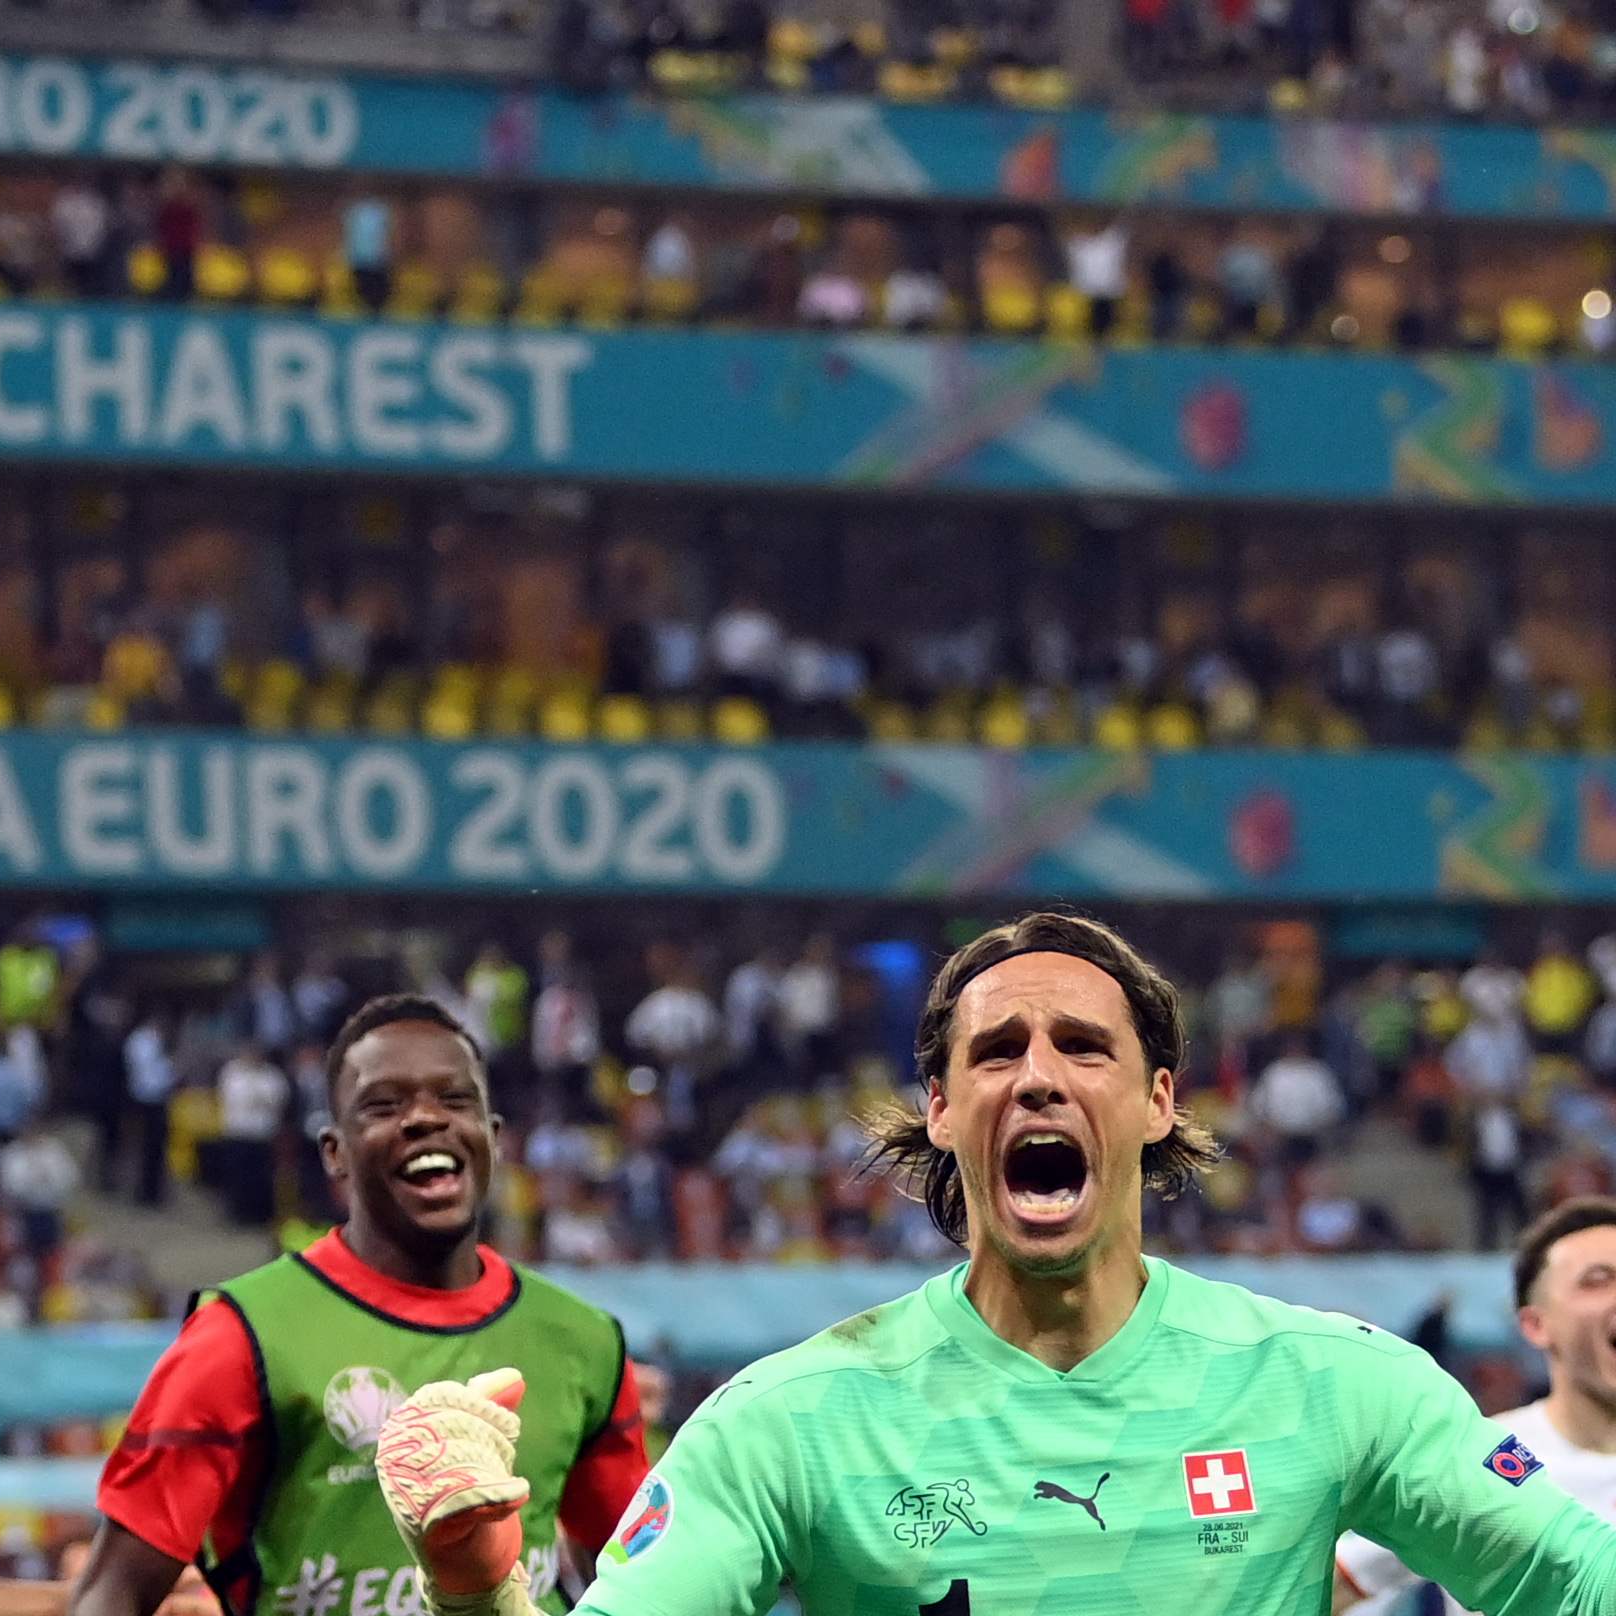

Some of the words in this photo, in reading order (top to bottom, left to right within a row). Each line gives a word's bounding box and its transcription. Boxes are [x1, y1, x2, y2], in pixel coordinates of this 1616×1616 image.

[103, 61, 359, 168] 2020
[57, 742, 432, 880] EURO
[447, 749, 784, 884] 2020
[1197, 1532, 1220, 1545] FRA
[1231, 1530, 1249, 1543] SUI
